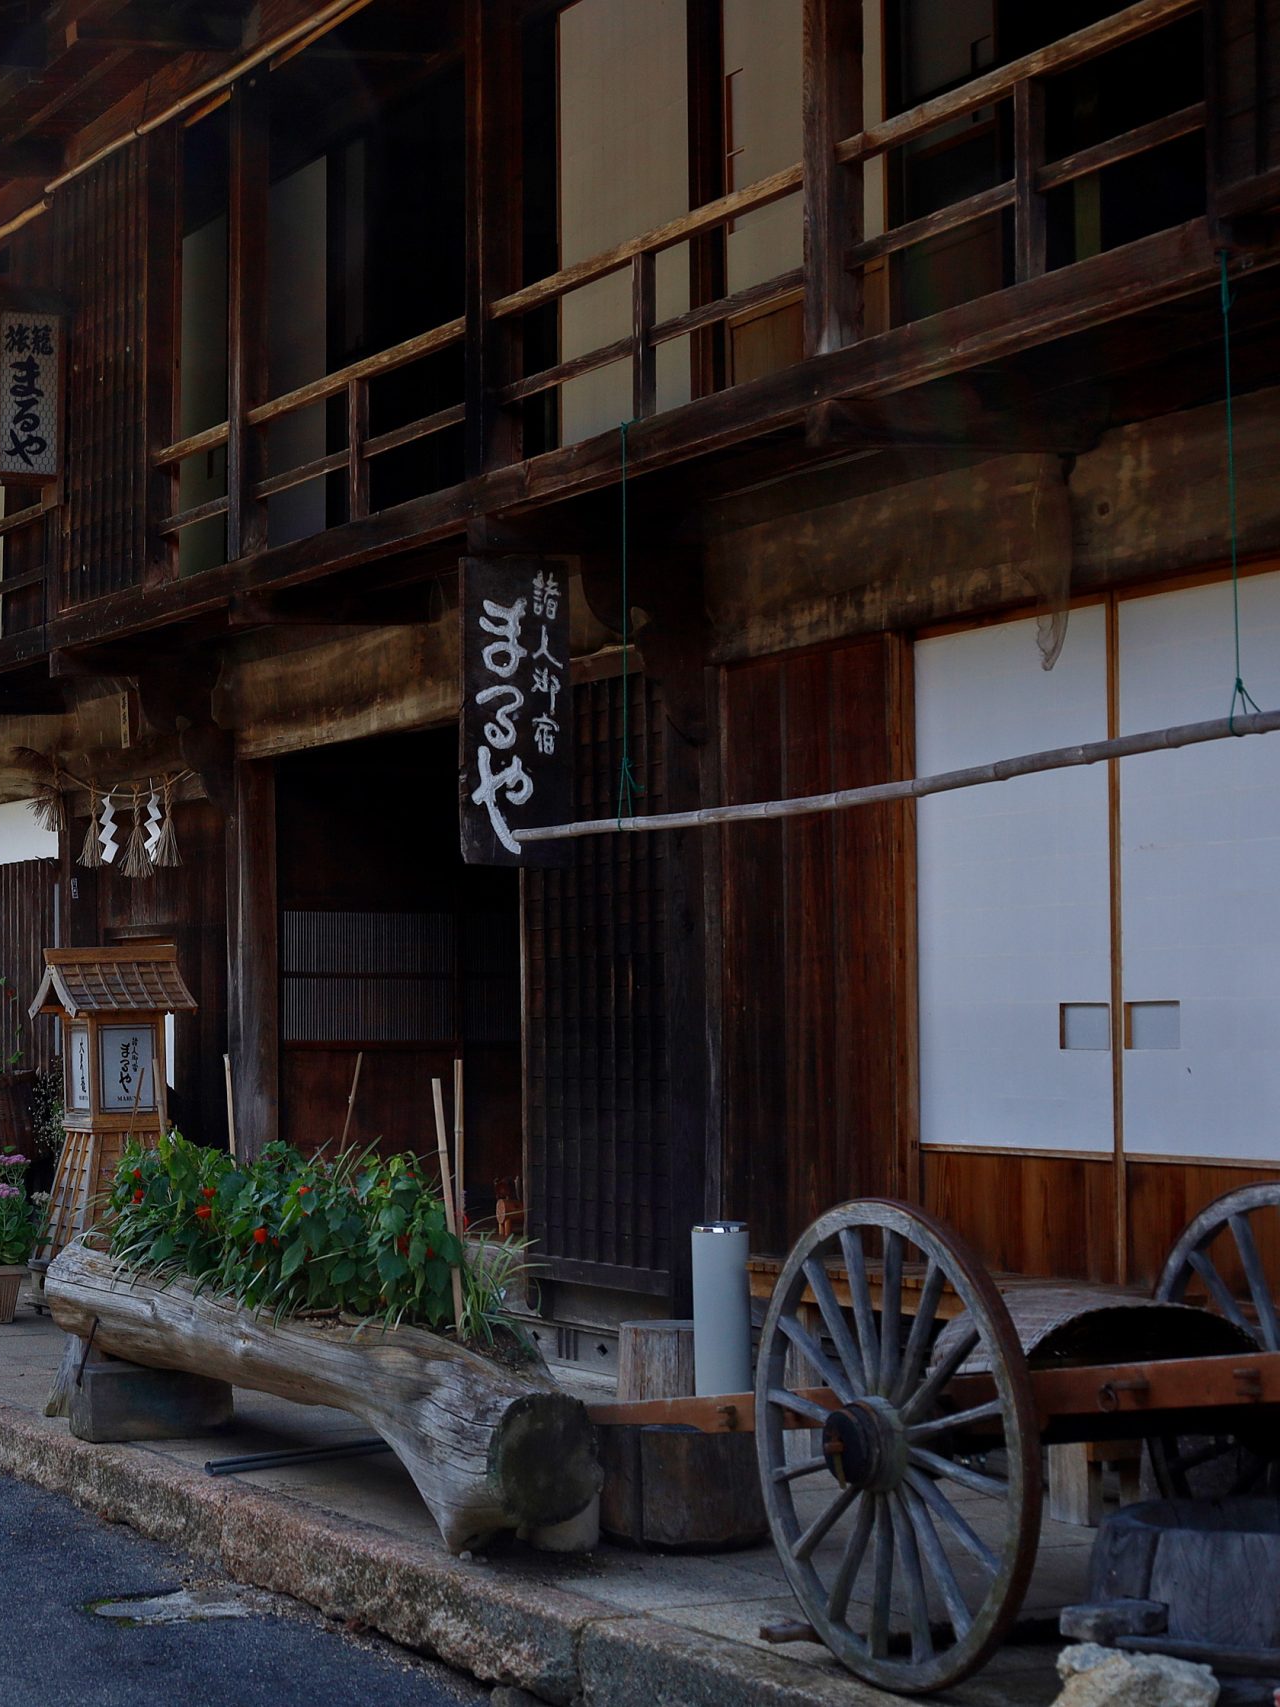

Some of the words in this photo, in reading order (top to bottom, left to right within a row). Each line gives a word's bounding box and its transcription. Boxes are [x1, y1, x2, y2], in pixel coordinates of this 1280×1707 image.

[4, 355, 47, 467] まるや
[472, 597, 534, 855] まるや
[118, 1042, 132, 1093] まるや
